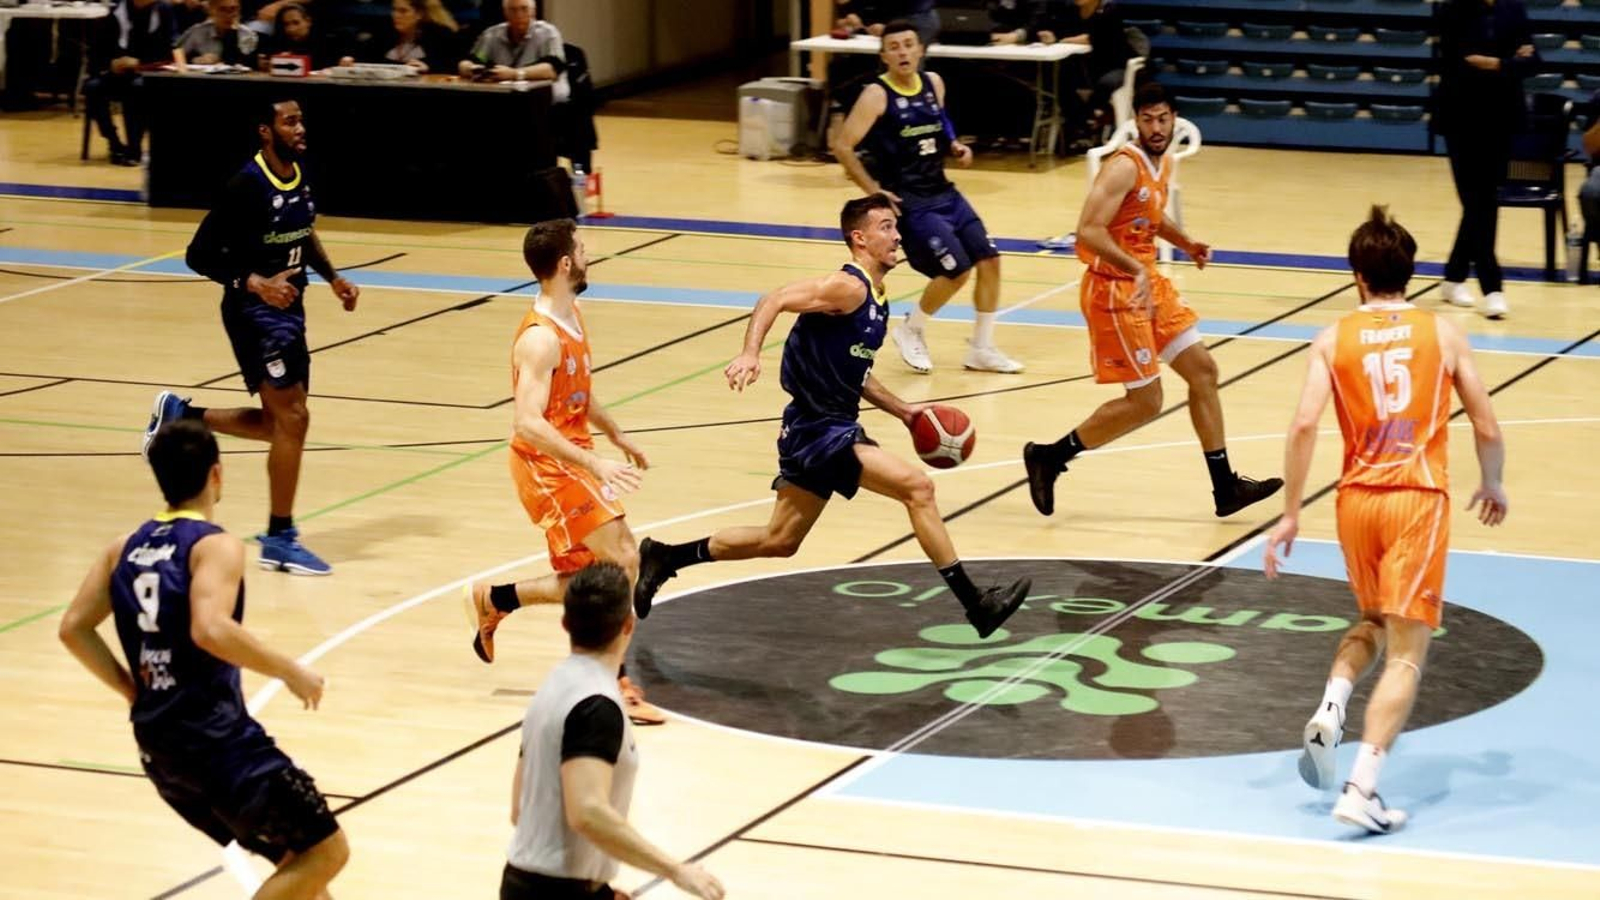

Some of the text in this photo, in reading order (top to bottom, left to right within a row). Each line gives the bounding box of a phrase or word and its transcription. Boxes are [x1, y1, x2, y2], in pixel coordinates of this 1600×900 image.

[287, 245, 302, 267] 11
[1362, 347, 1414, 421] 15
[133, 572, 160, 632] 9
